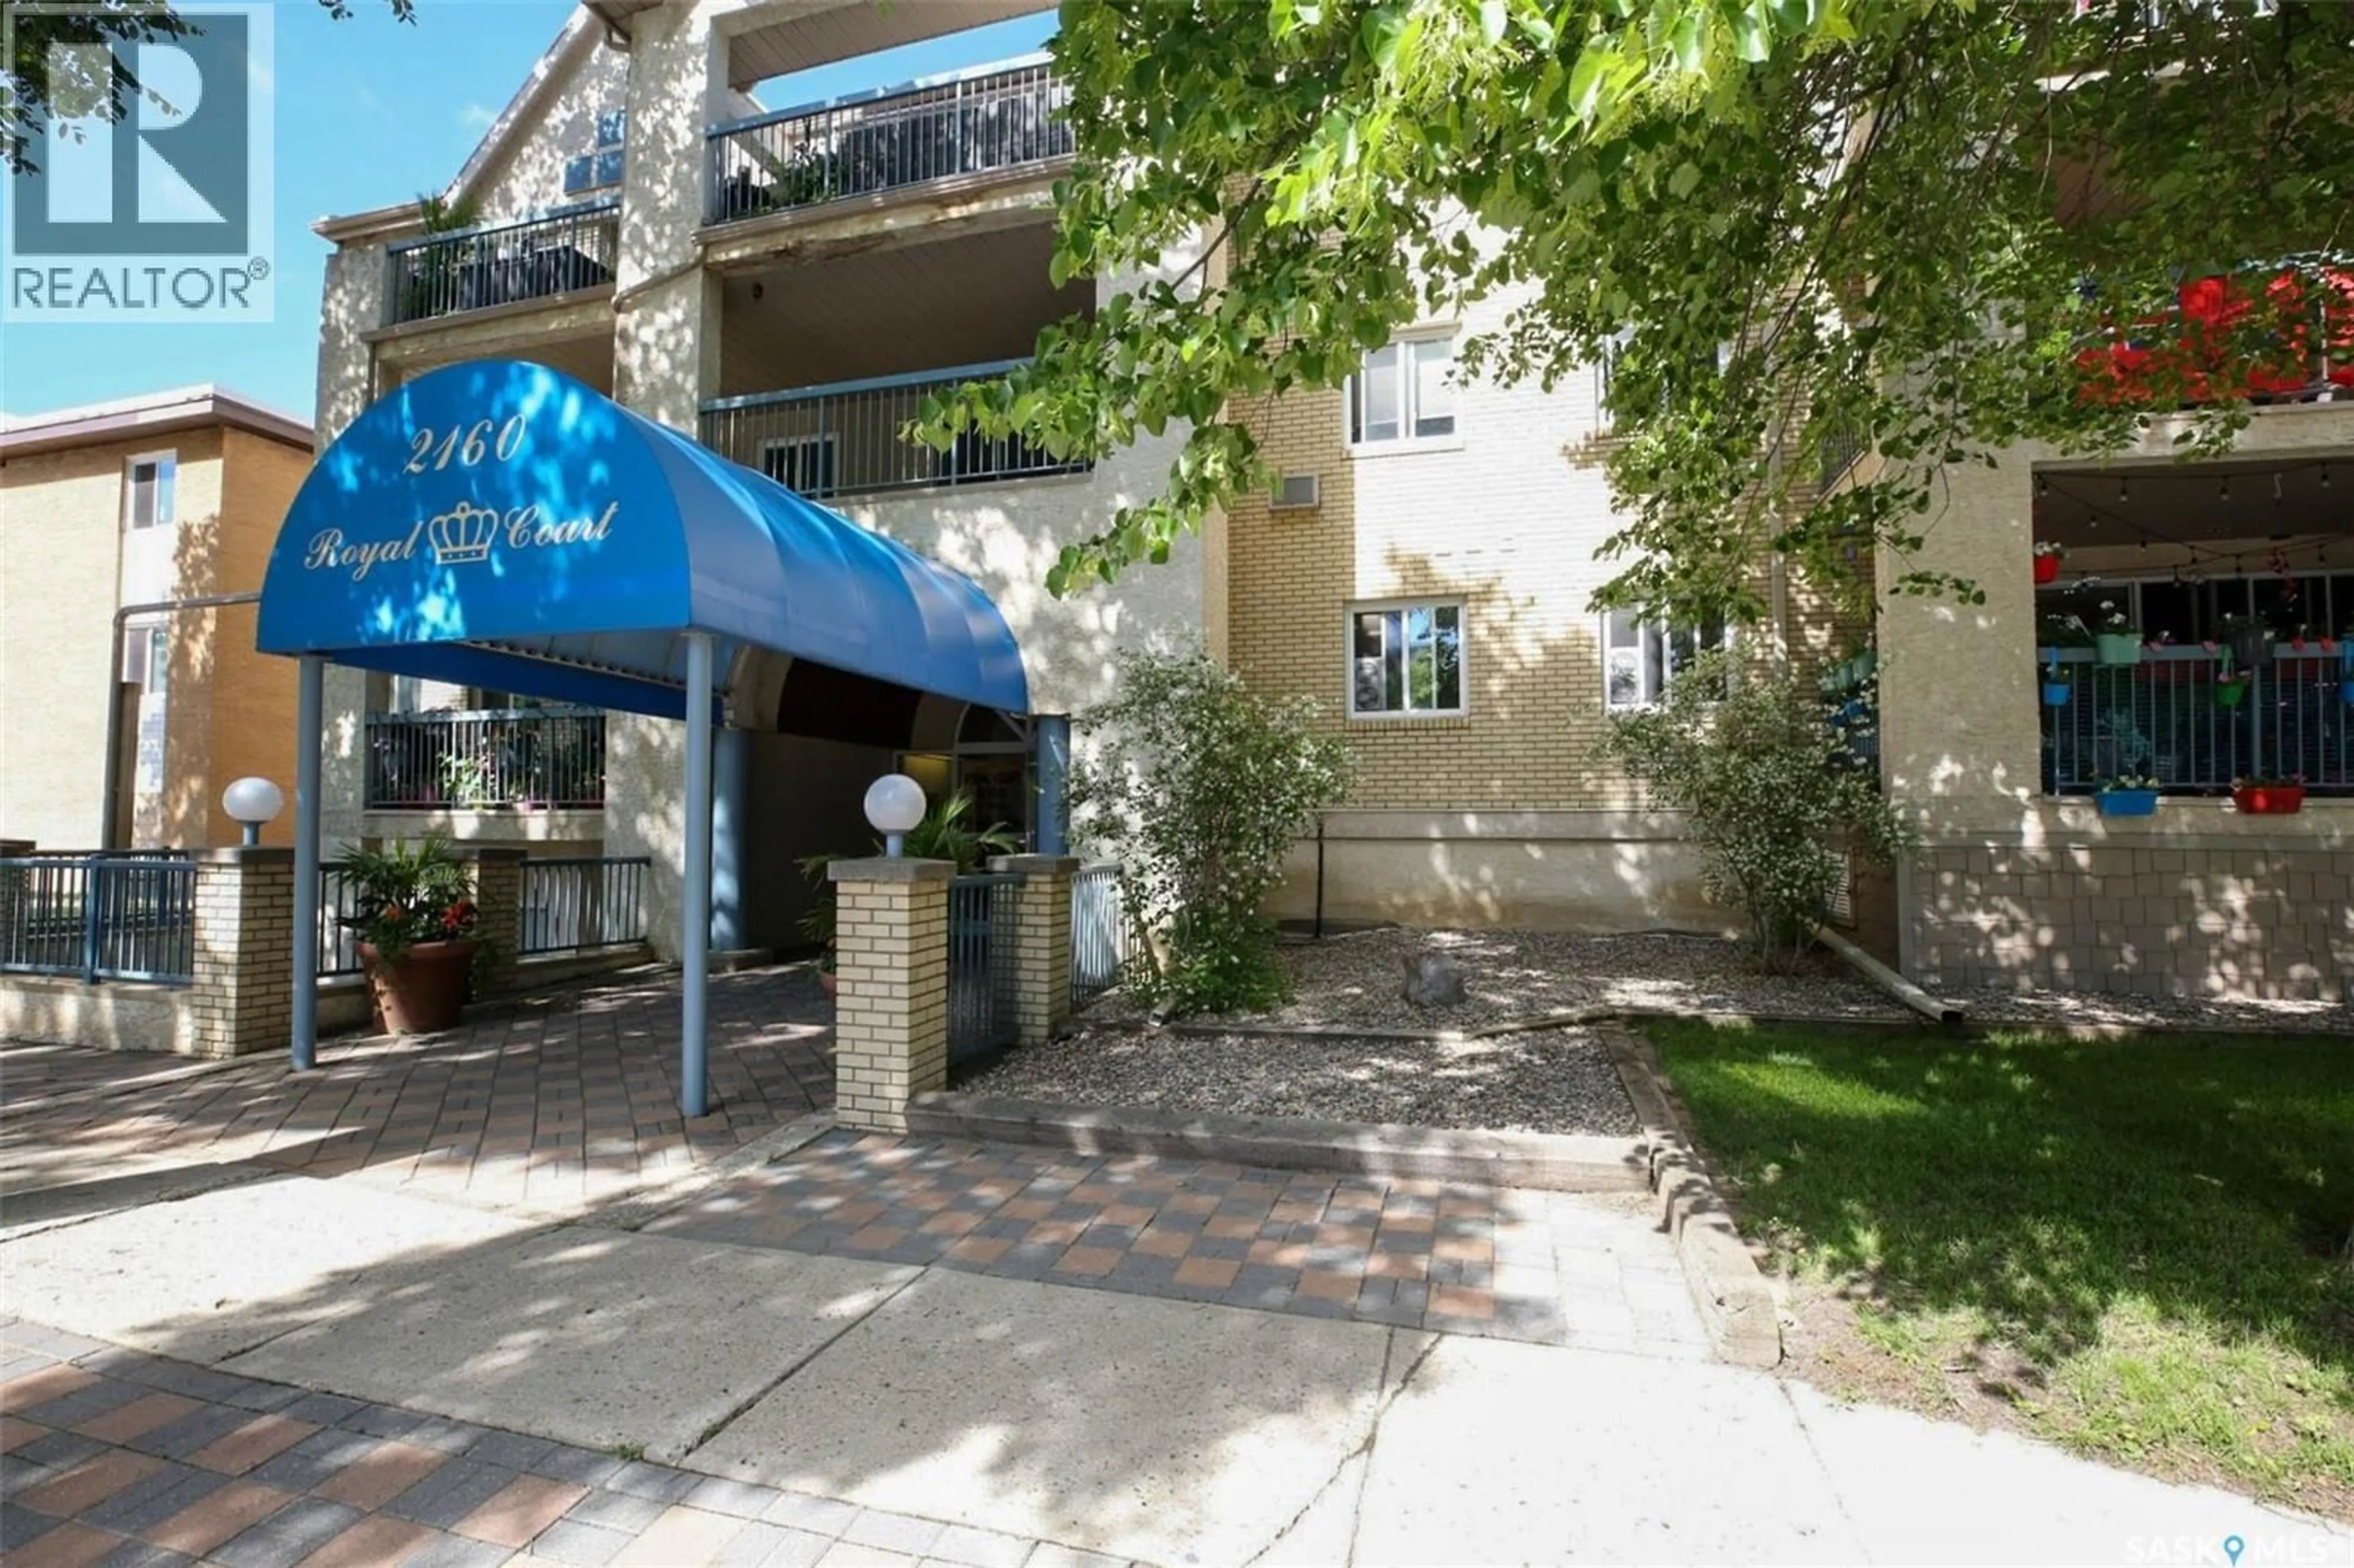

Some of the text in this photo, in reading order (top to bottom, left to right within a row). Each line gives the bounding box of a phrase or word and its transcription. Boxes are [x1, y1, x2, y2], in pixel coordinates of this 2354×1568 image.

[402, 413, 526, 474] 2160
[304, 501, 619, 582] Royal Court
